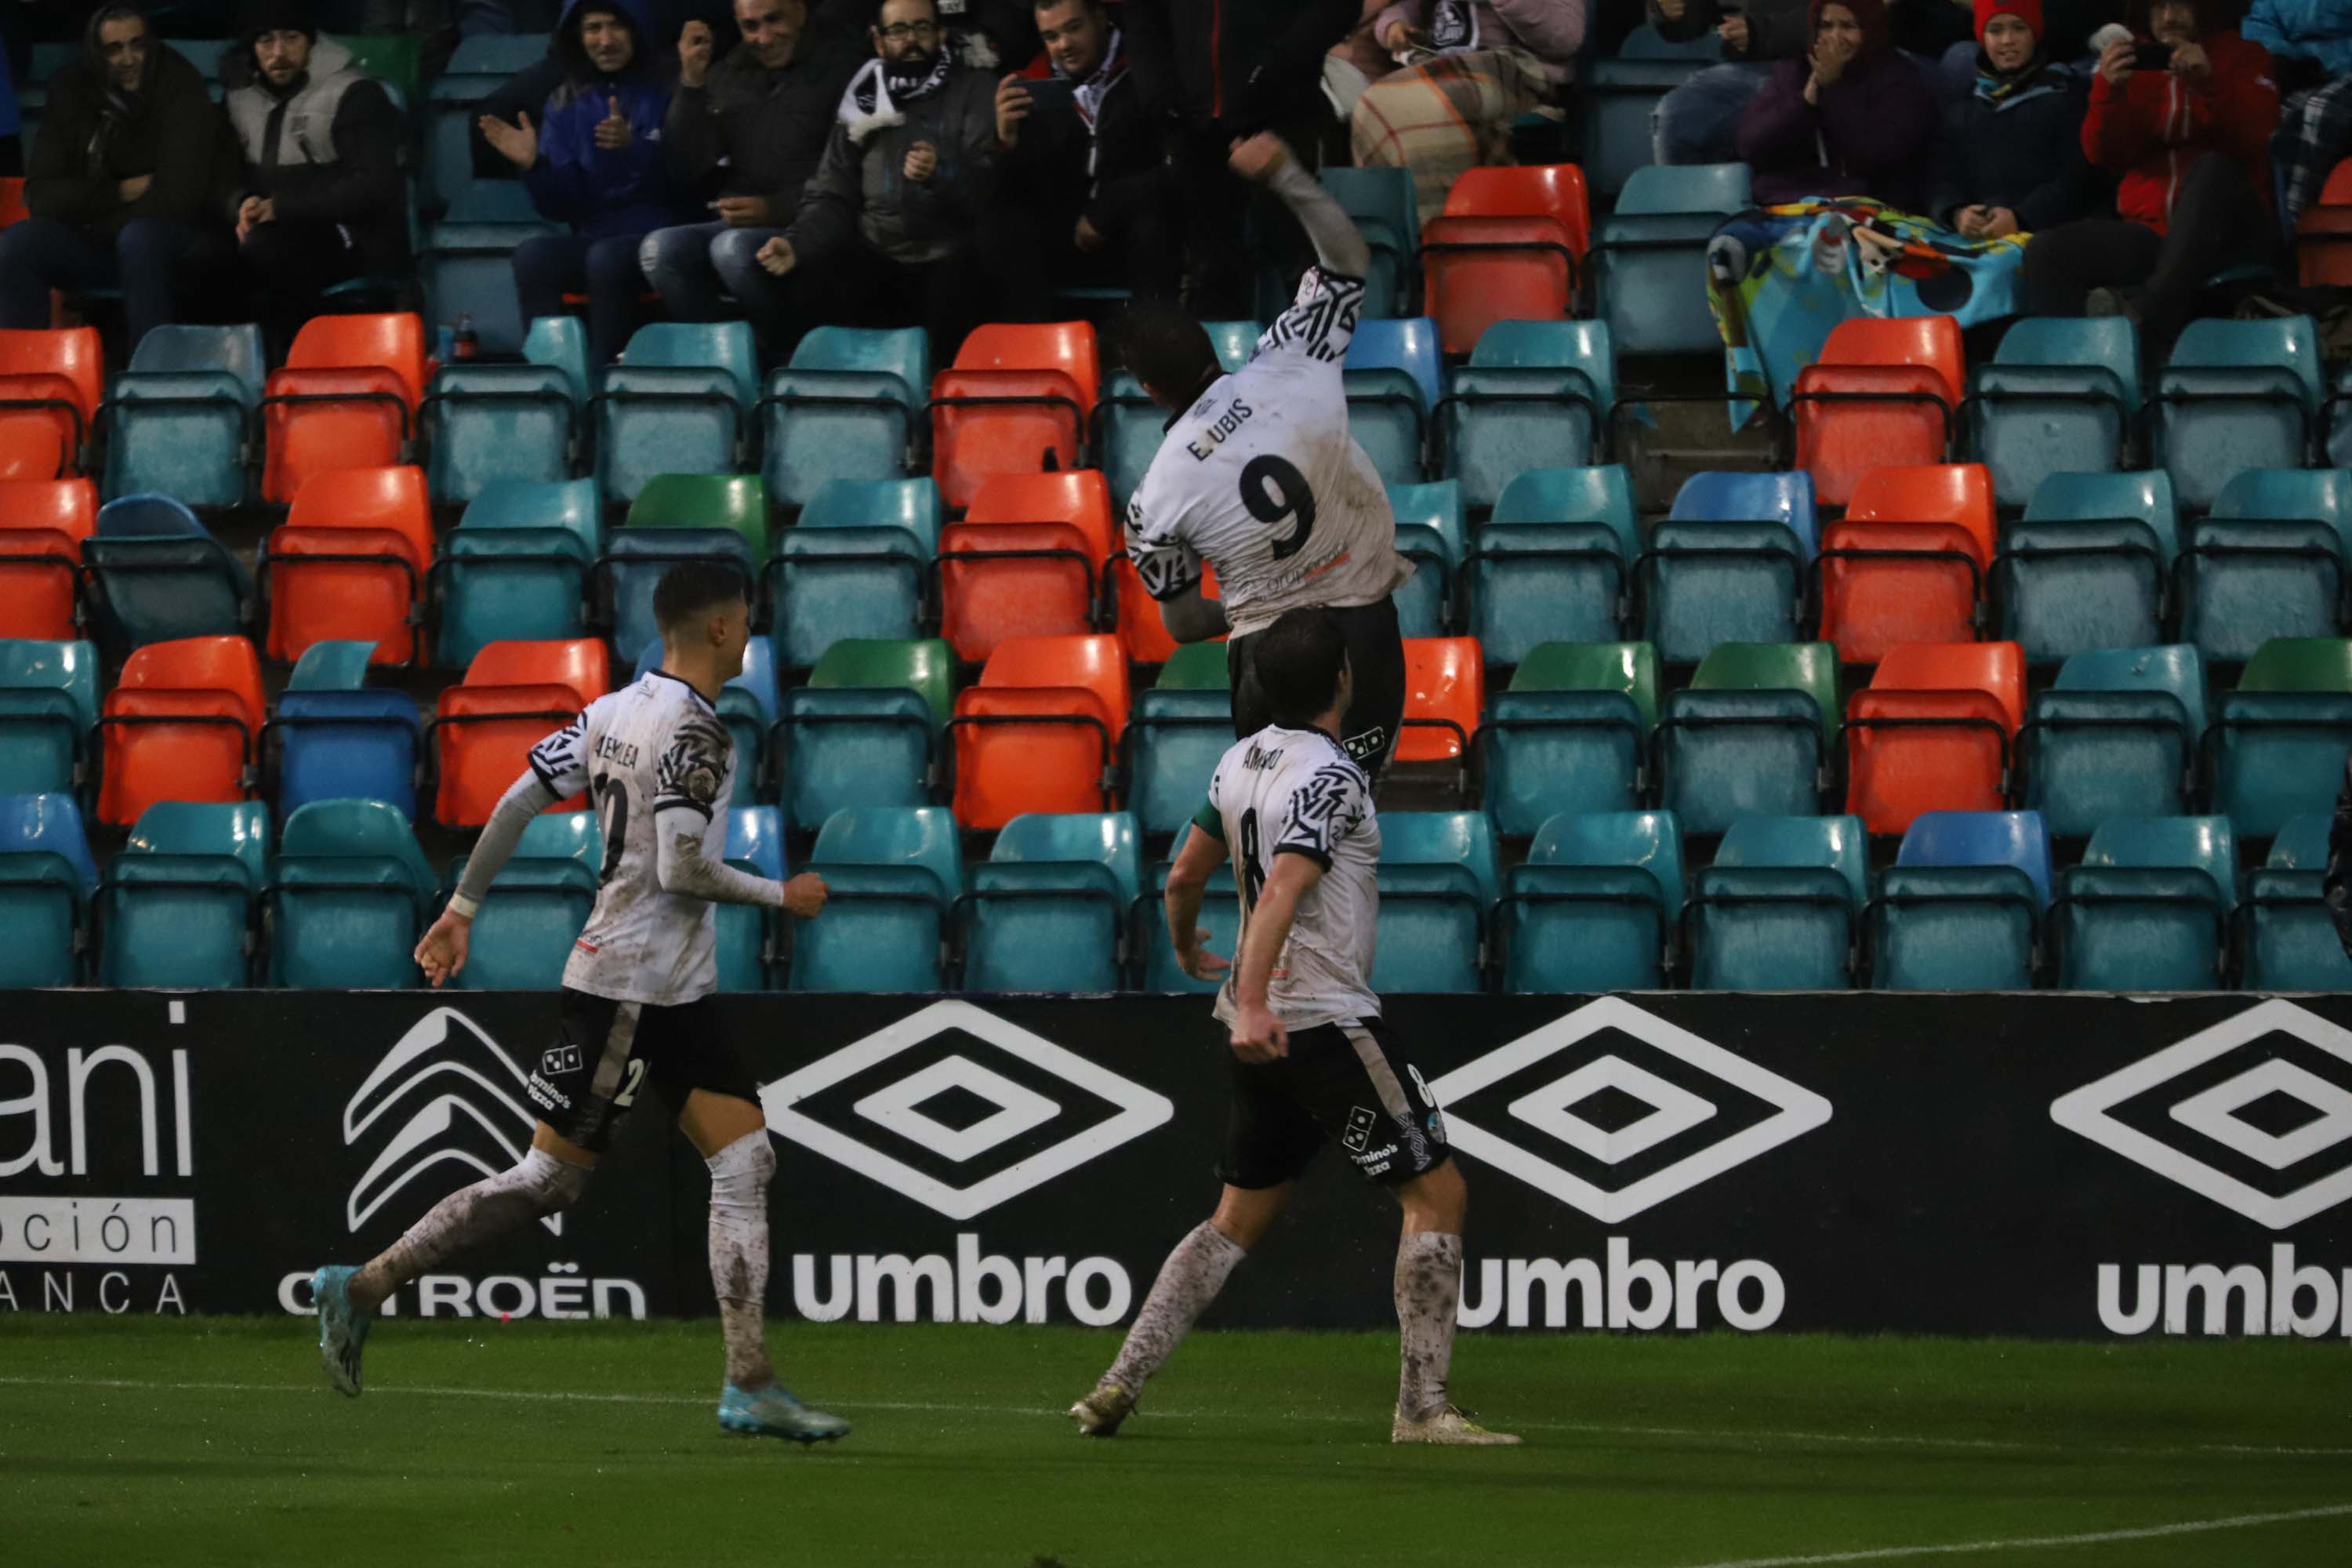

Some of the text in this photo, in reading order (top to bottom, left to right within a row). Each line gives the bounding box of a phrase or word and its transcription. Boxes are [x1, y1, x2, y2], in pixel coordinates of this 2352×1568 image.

[1207, 397, 1253, 444] UBIS
[1239, 454, 1316, 561] 9
[0, 1001, 192, 1176] ani
[613, 1058, 644, 1106] 2
[1406, 1064, 1435, 1108] 8
[0, 1202, 176, 1253] ción
[278, 1261, 647, 1321] CROËN
[793, 1232, 1132, 1327] umbro
[1457, 1236, 1786, 1331] umbro
[2097, 1241, 2352, 1338] umb
